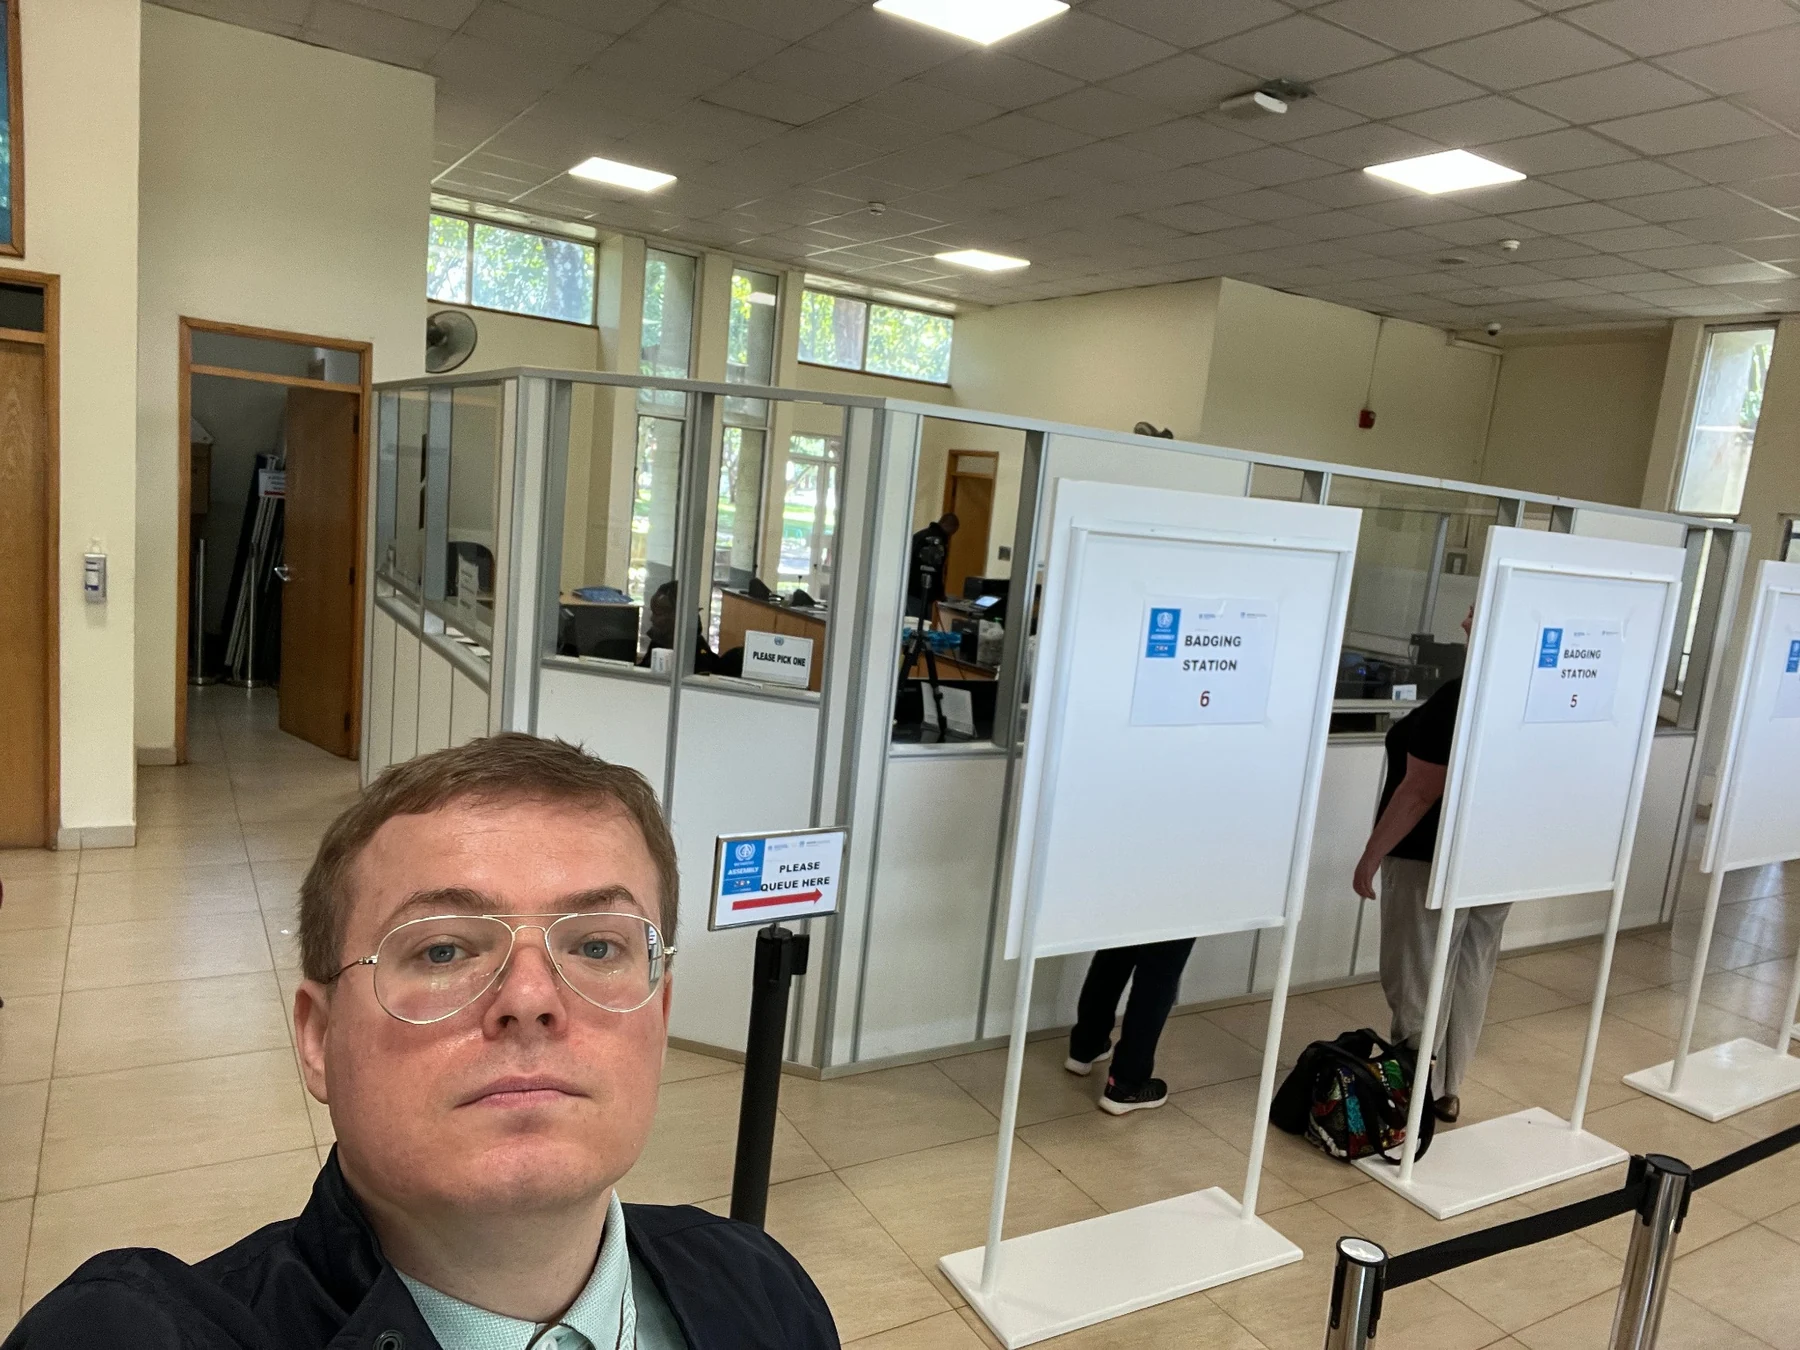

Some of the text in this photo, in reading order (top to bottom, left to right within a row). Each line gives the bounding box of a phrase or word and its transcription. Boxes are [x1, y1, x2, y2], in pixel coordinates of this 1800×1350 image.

[1184, 635, 1242, 647] BADGING
[753, 651, 806, 667] PLEASE PICK ONE
[1563, 649, 1602, 659] BADGING
[1182, 659, 1238, 671] STATION
[1560, 669, 1597, 679] STATION
[1200, 690, 1211, 707] 6
[1570, 694, 1578, 708] 5
[727, 866, 760, 876] ASSEMBLY
[779, 861, 820, 873] PLEASE
[760, 880, 799, 892] QUEUE
[802, 876, 830, 888] HERE
